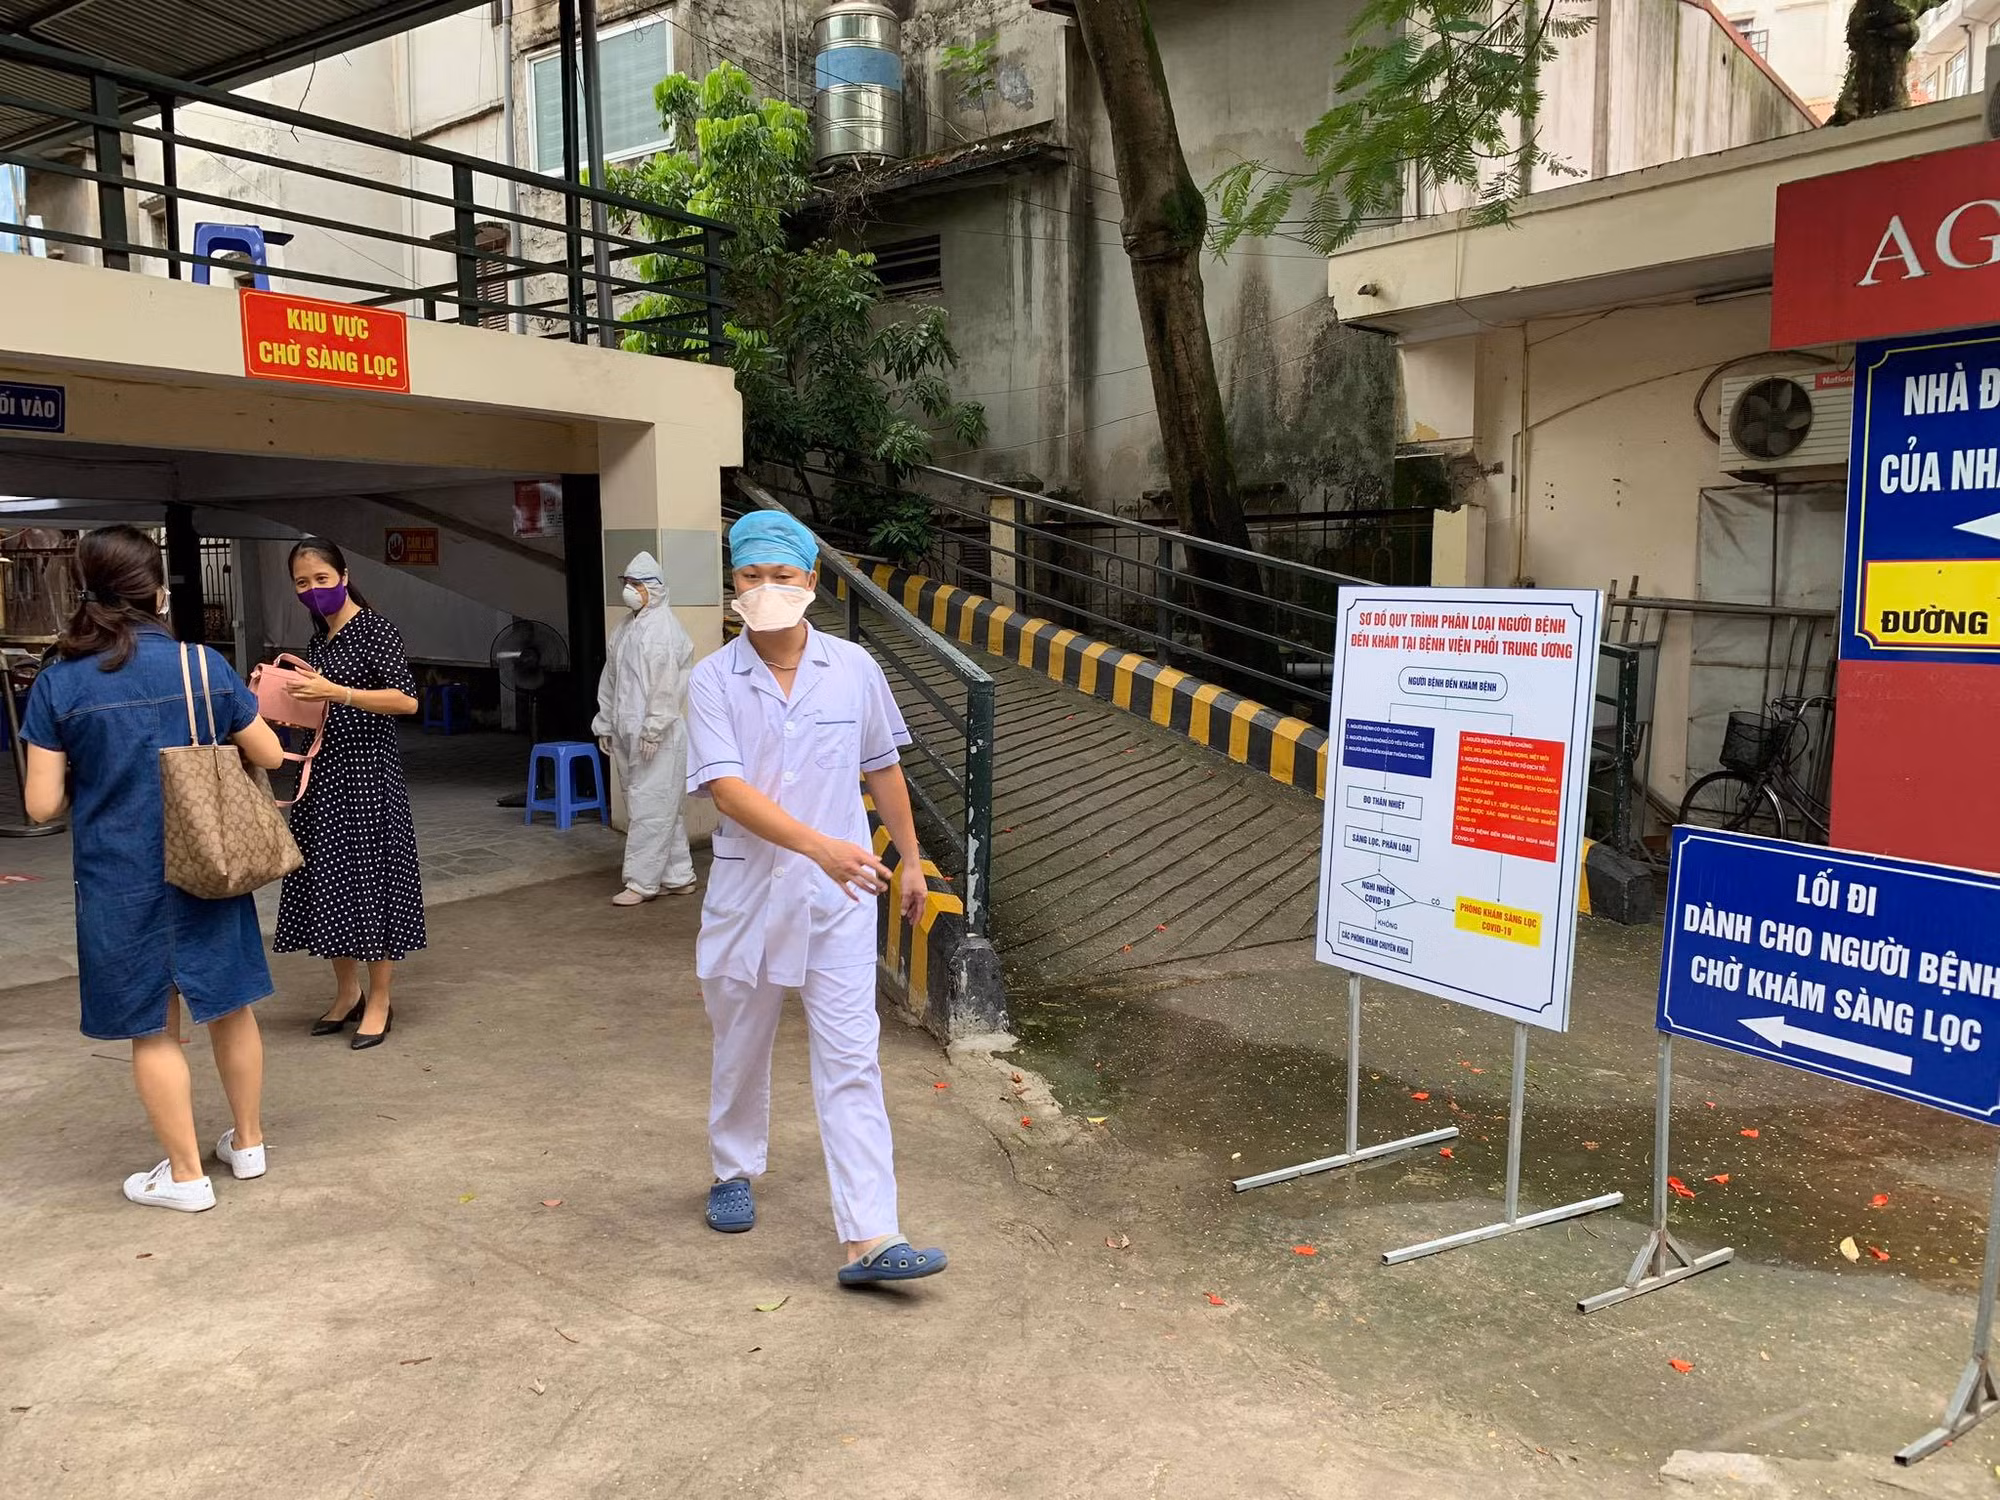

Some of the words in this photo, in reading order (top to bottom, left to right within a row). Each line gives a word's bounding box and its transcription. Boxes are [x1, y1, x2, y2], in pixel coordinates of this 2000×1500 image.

[287, 308, 327, 334] KHU
[332, 314, 369, 342] VỰC
[259, 338, 301, 366] CHỜ
[306, 344, 358, 373] SÀNG
[364, 353, 398, 380] LỌC
[1903, 362, 1969, 416] NHÀ
[20, 396, 56, 418] VÀO
[1880, 436, 1942, 494] CỦA
[1951, 447, 2000, 491] NH
[1360, 612, 1372, 626] SƠ
[1374, 608, 1387, 626] ĐỒ
[1389, 614, 1407, 627] QUY
[1411, 611, 1438, 628] TRÌNH
[1442, 612, 1469, 629] PHÂN
[1472, 615, 1495, 633] LOẠI
[1498, 613, 1531, 632] NGƯỜI
[1535, 615, 1565, 636] BỆNH
[1881, 604, 1988, 634] ĐƯỜNG
[1351, 629, 1369, 647] ĐẾN
[1372, 632, 1399, 649] KHÁM
[1402, 636, 1417, 652] TẠI
[1419, 634, 1445, 653] BỆNH
[1448, 635, 1471, 656] VIỆN
[1474, 634, 1499, 655] PHỔI
[1502, 641, 1537, 657] TRUNG
[1541, 642, 1573, 659] ƯƠNG
[1408, 675, 1426, 686] NGƯỜI
[1427, 676, 1444, 688] BỆNH
[1459, 678, 1478, 690] KHÁM
[1479, 679, 1497, 693] BỆNH
[1362, 881, 1375, 891] NGHI
[1365, 894, 1390, 907] COVID-19
[1796, 868, 1839, 909] LỐI
[1847, 884, 1878, 917] ĐI
[1460, 903, 1482, 915] PHÒNG
[1483, 908, 1502, 920] KHÁM
[1504, 912, 1522, 925] SÀNG
[1482, 921, 1512, 936] COVID-19
[1683, 901, 1752, 944] DÀNH
[1759, 919, 1813, 957] CHO
[1820, 932, 1911, 979] NGƯỜI
[1918, 950, 2000, 1000] BỆNH
[1690, 955, 1742, 992] CHỜ
[1747, 971, 1826, 1014] KHÁM
[1833, 987, 1914, 1036] SÀNG
[1922, 1008, 1982, 1053] LỌC
